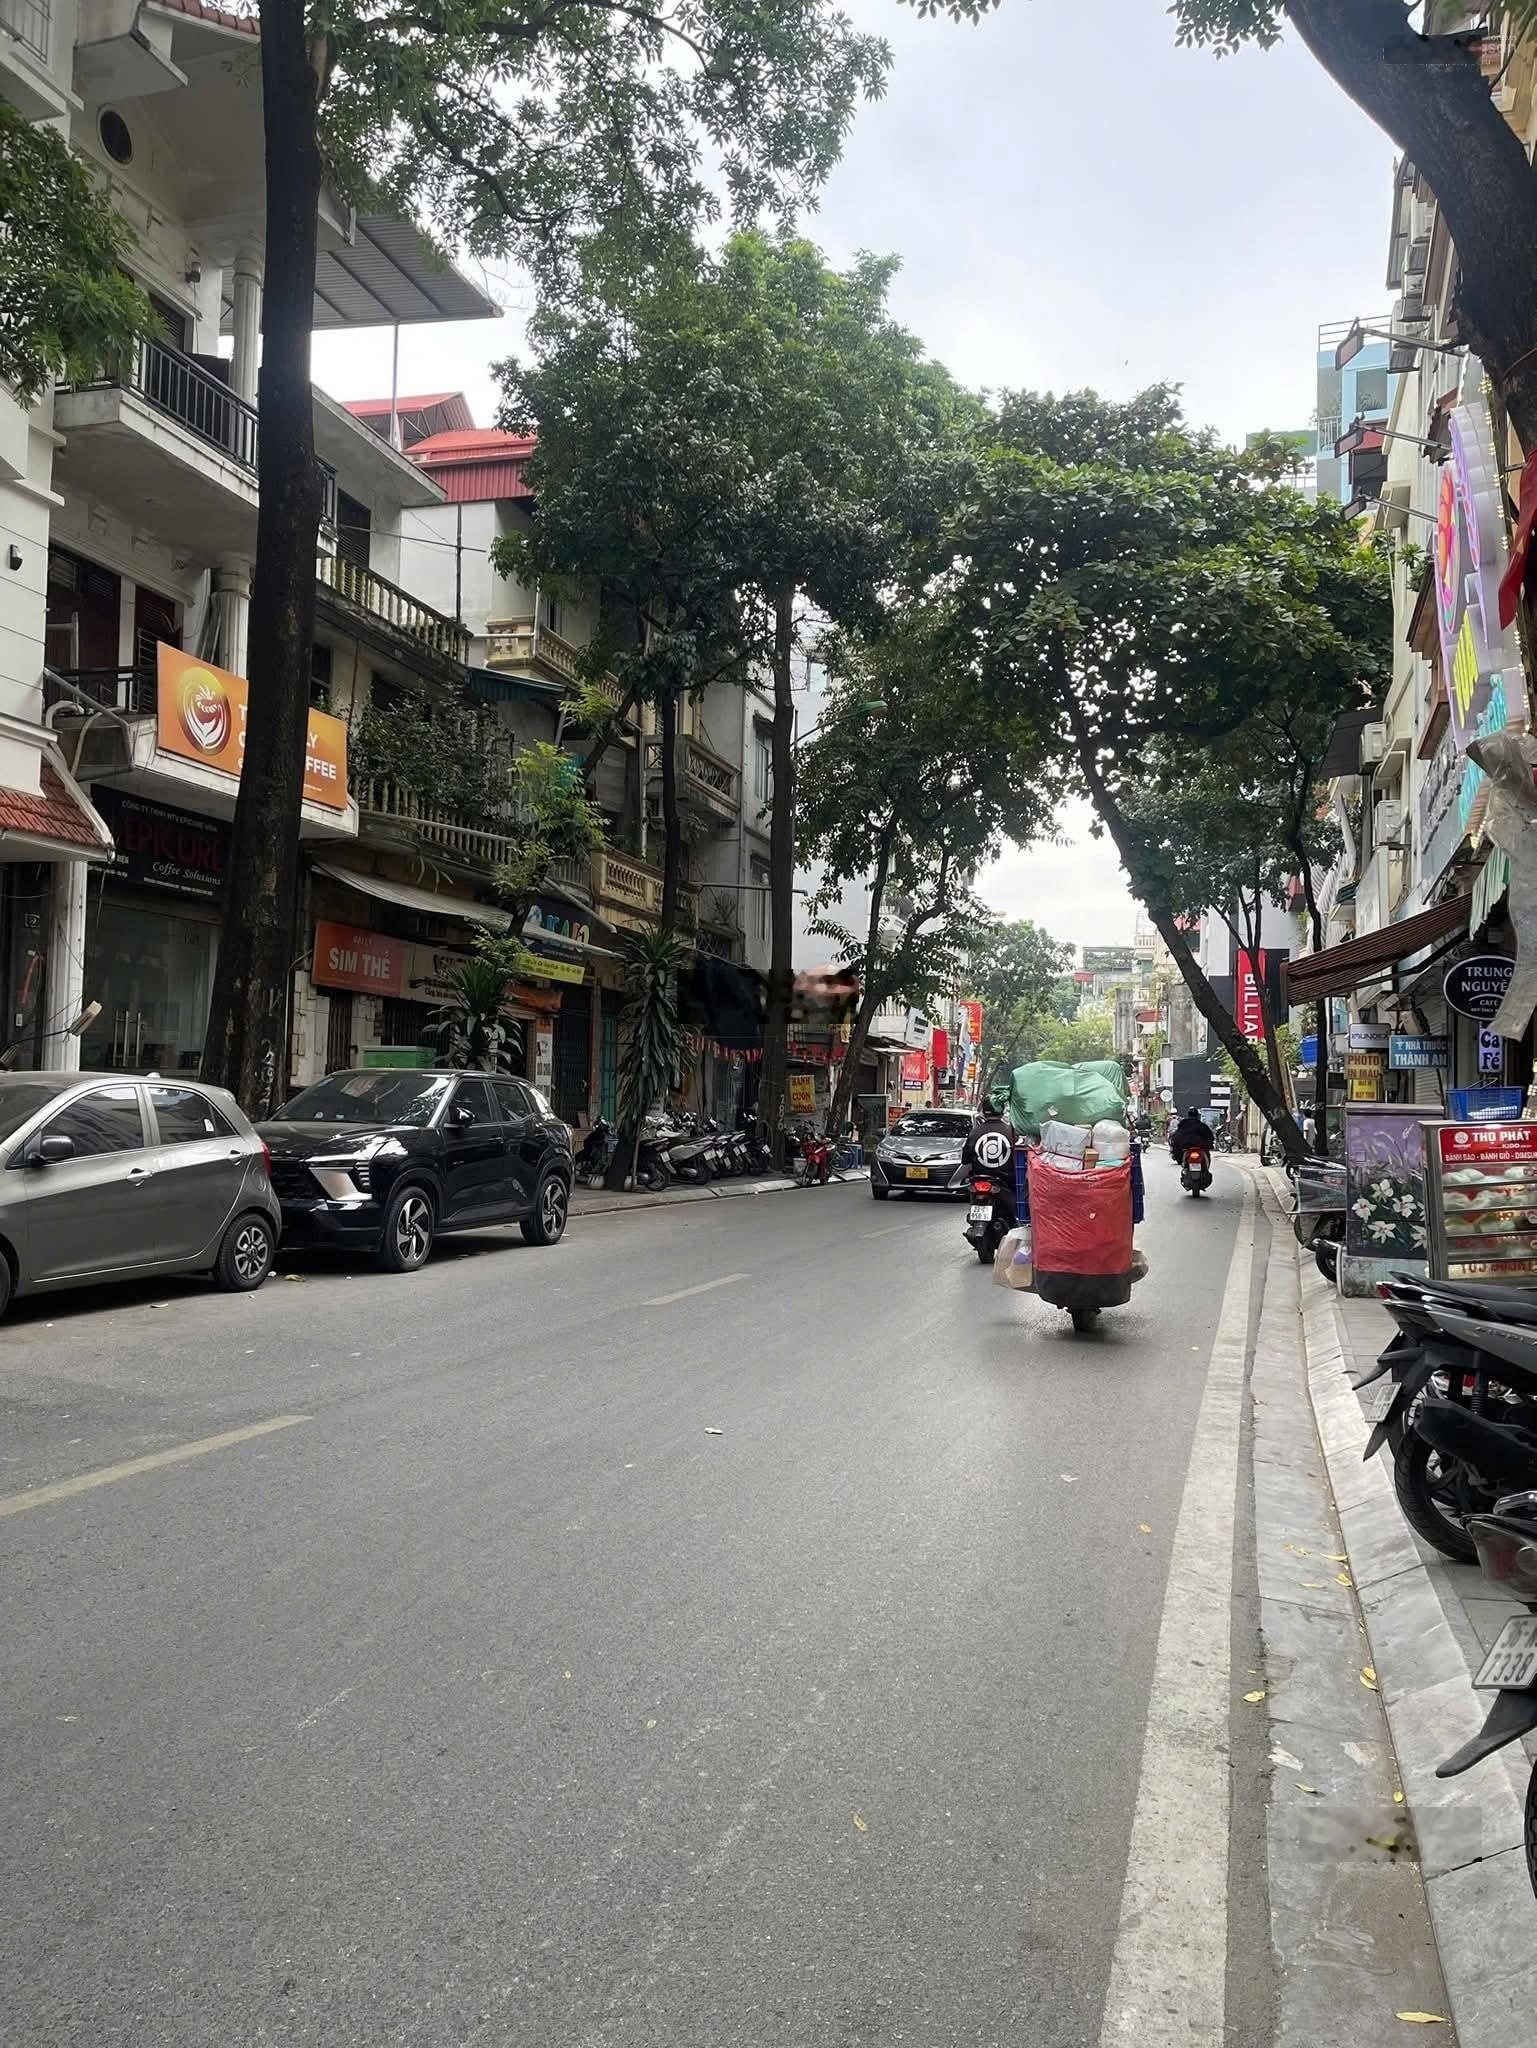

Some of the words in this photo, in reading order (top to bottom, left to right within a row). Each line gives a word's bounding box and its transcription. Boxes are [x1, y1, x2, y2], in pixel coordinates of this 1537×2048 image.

[152, 861, 182, 876] Coffee
[182, 868, 222, 886] Solutions
[329, 946, 358, 973] SIM
[1465, 966, 1513, 977] TRUNG
[1461, 979, 1509, 992] NGUYÊ
[1406, 1039, 1422, 1050] NHÀ
[1480, 1030, 1500, 1049] Ca
[1348, 1055, 1379, 1065] PHOTO
[1394, 1052, 1429, 1066] THÀNH
[1431, 1053, 1449, 1066] AN
[1481, 1051, 1500, 1070] Fé
[1472, 1131, 1497, 1144] THỌ
[1499, 1128, 1531, 1141] PHÁT
[1499, 1150, 1511, 1160] GIÒ
[1481, 1652, 1534, 1682] 7338
